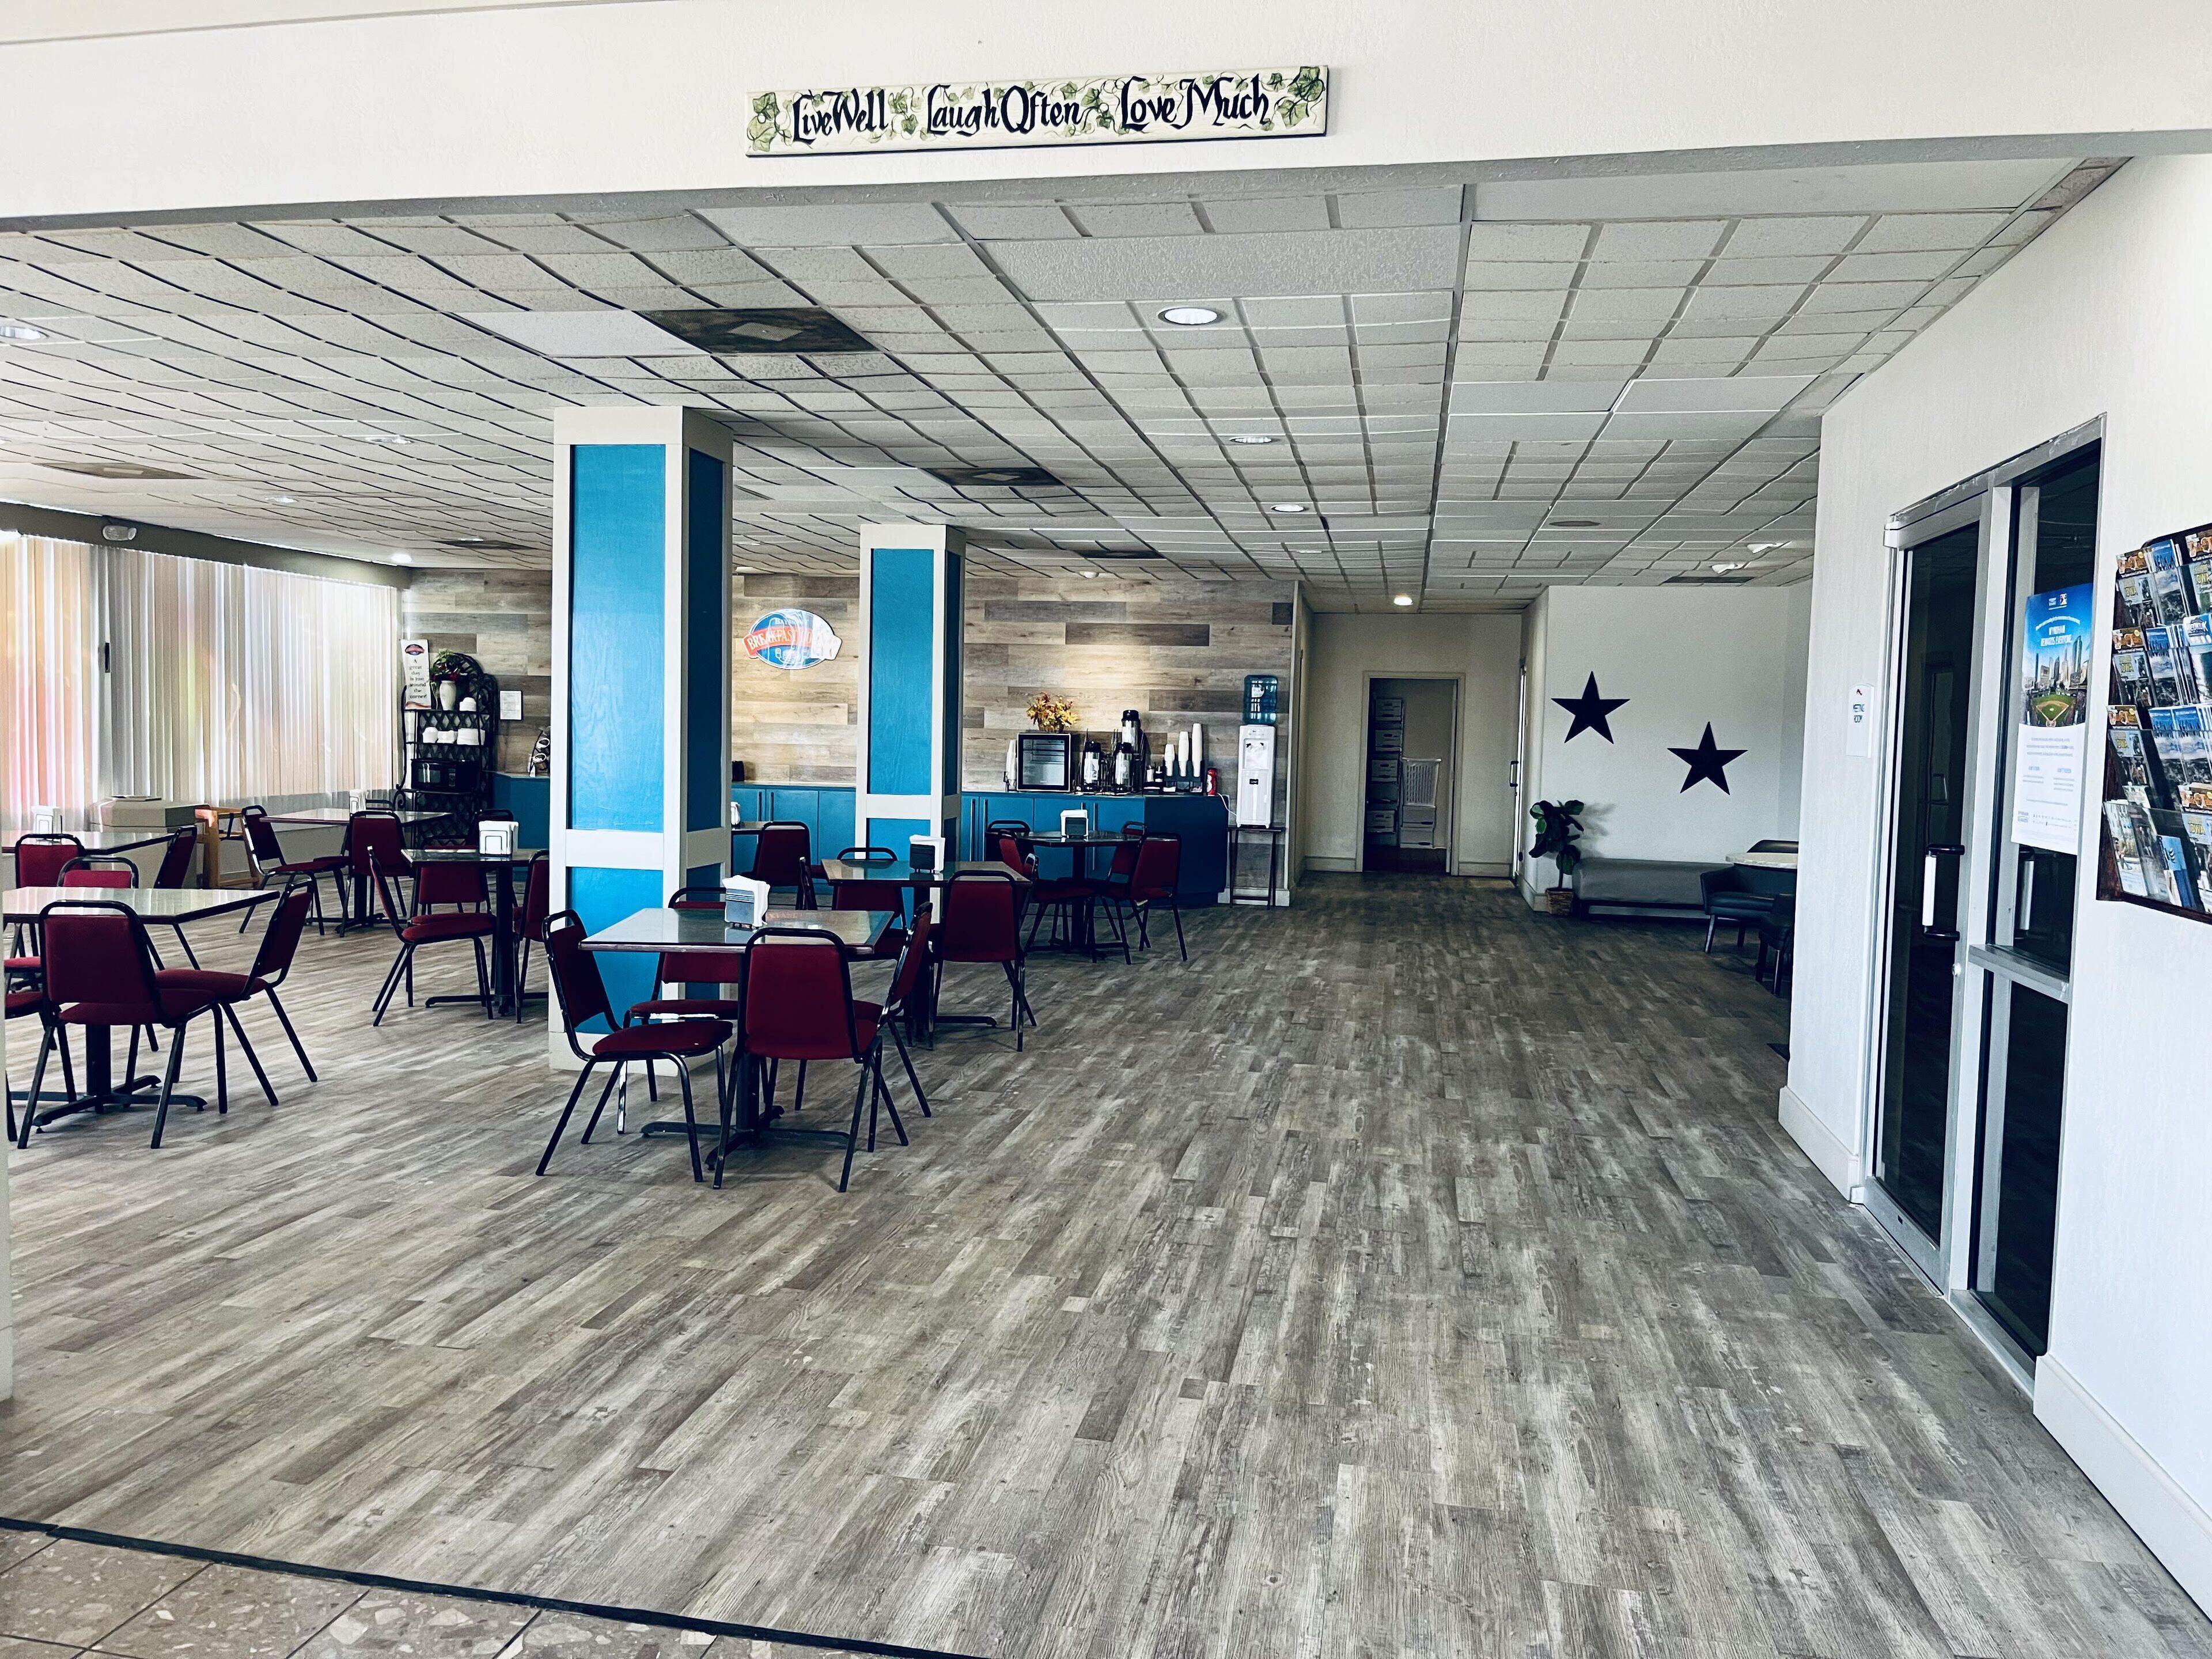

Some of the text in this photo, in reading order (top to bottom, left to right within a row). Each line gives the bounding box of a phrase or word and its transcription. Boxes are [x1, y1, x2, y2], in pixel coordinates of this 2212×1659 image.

[793, 73, 1269, 145] Live Well Laugh Often Love Much
[747, 629, 797, 650] BREAKFAST
